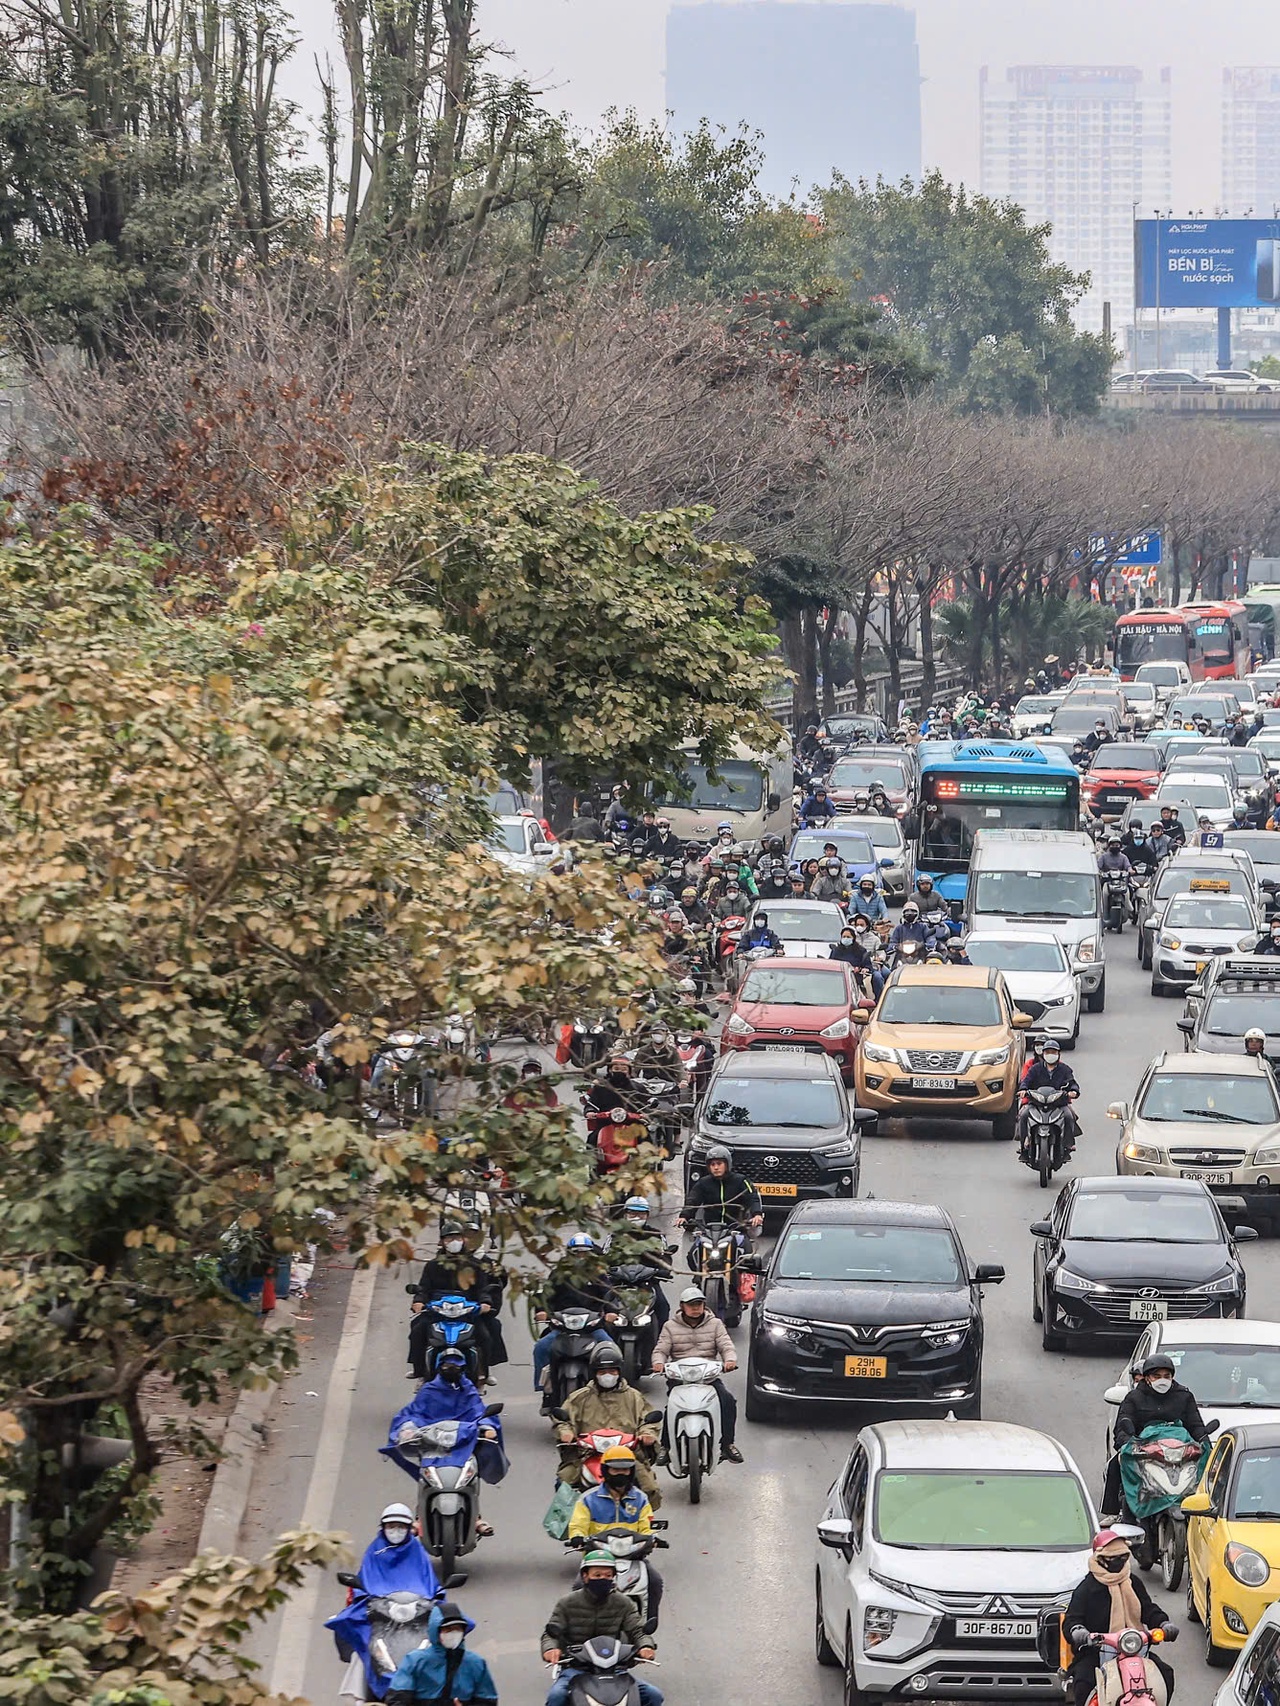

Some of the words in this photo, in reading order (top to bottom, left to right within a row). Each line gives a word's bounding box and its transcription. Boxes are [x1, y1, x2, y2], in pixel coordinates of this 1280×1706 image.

[1183, 273, 1208, 282] nước
[1210, 273, 1234, 284] sạch
[913, 1079, 954, 1089] 30F-834.92
[1140, 1302, 1157, 1311] 90A
[1135, 1311, 1164, 1321] 171.80
[857, 1357, 875, 1367] 29H
[849, 1367, 882, 1377] 938.06
[963, 1622, 1032, 1635] 30F-867.00
